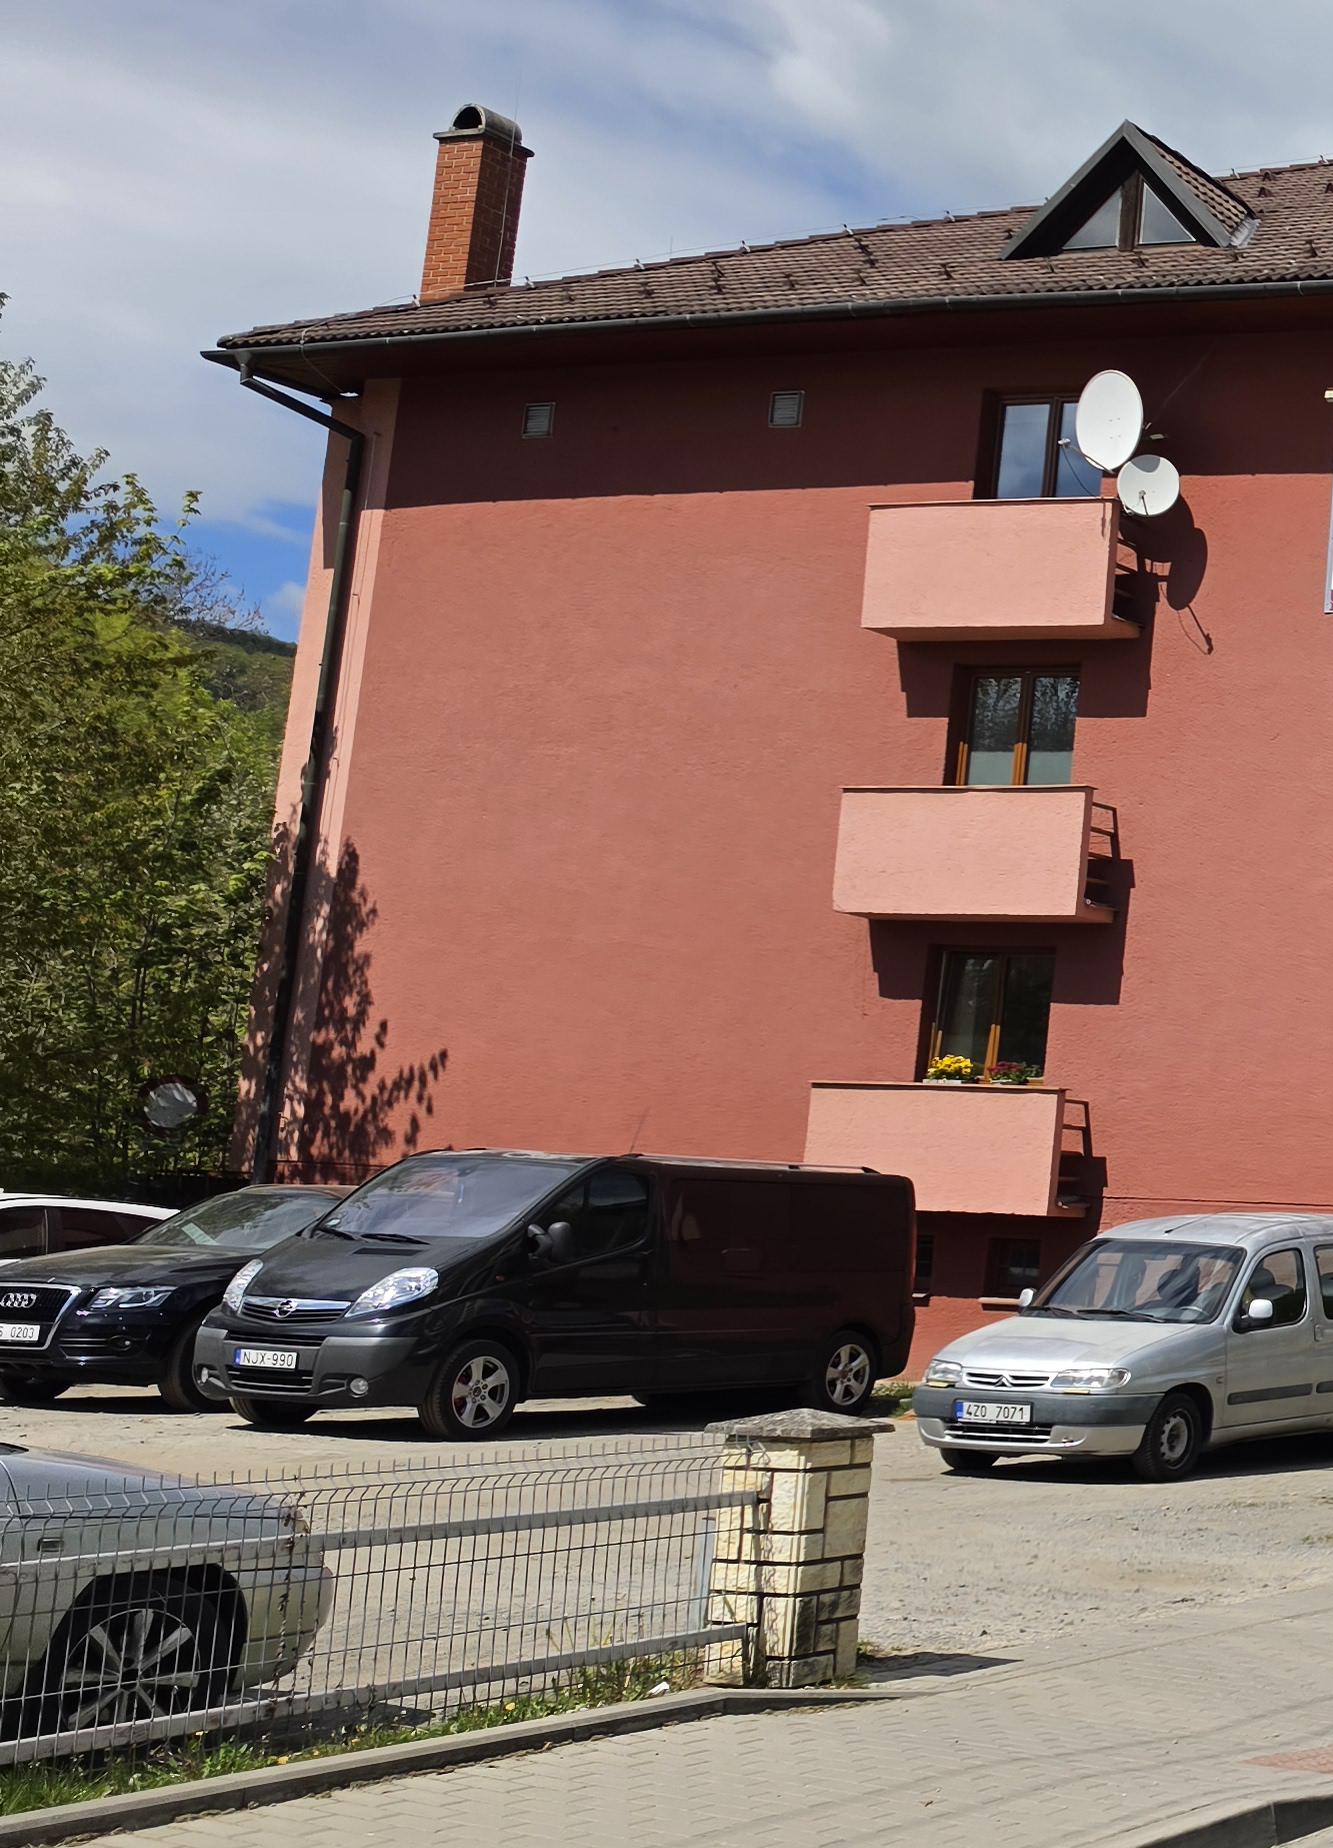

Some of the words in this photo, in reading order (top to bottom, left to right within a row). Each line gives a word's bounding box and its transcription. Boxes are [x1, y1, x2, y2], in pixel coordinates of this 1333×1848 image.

[10, 1326, 35, 1339] 0203
[243, 1350, 294, 1367] NJX-990
[995, 1405, 1025, 1420] 7071
